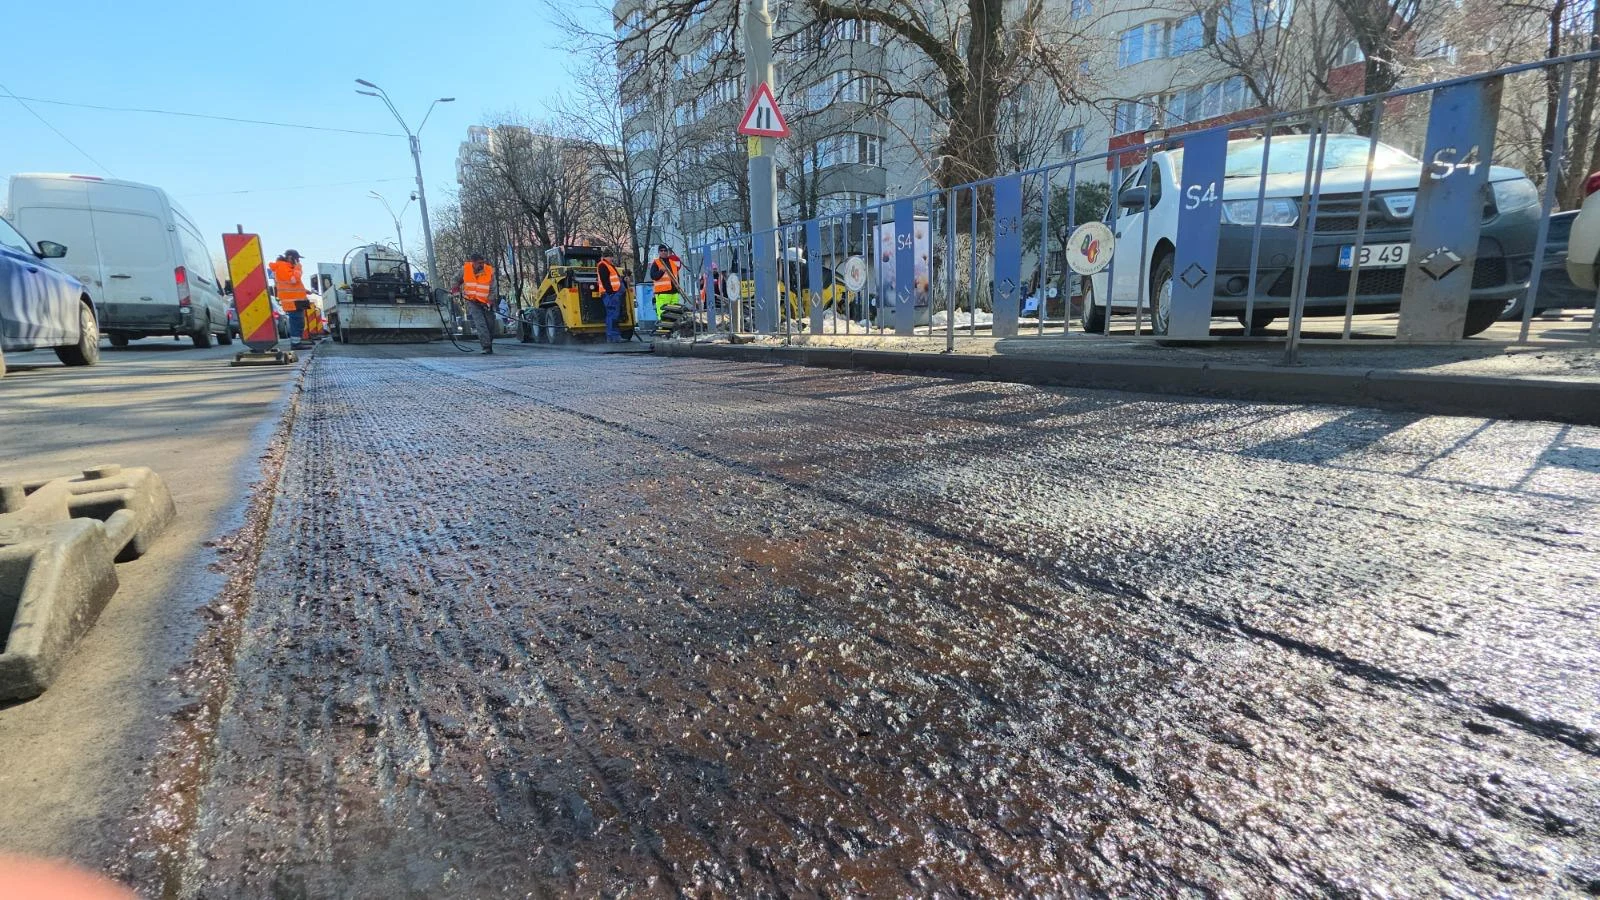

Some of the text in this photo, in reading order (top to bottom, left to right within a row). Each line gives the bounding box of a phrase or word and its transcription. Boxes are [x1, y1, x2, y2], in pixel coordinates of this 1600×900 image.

[1430, 145, 1482, 180] S4
[1186, 182, 1218, 210] S4
[999, 216, 1018, 237] S4
[897, 232, 913, 251] S4
[1378, 246, 1403, 263] 49
